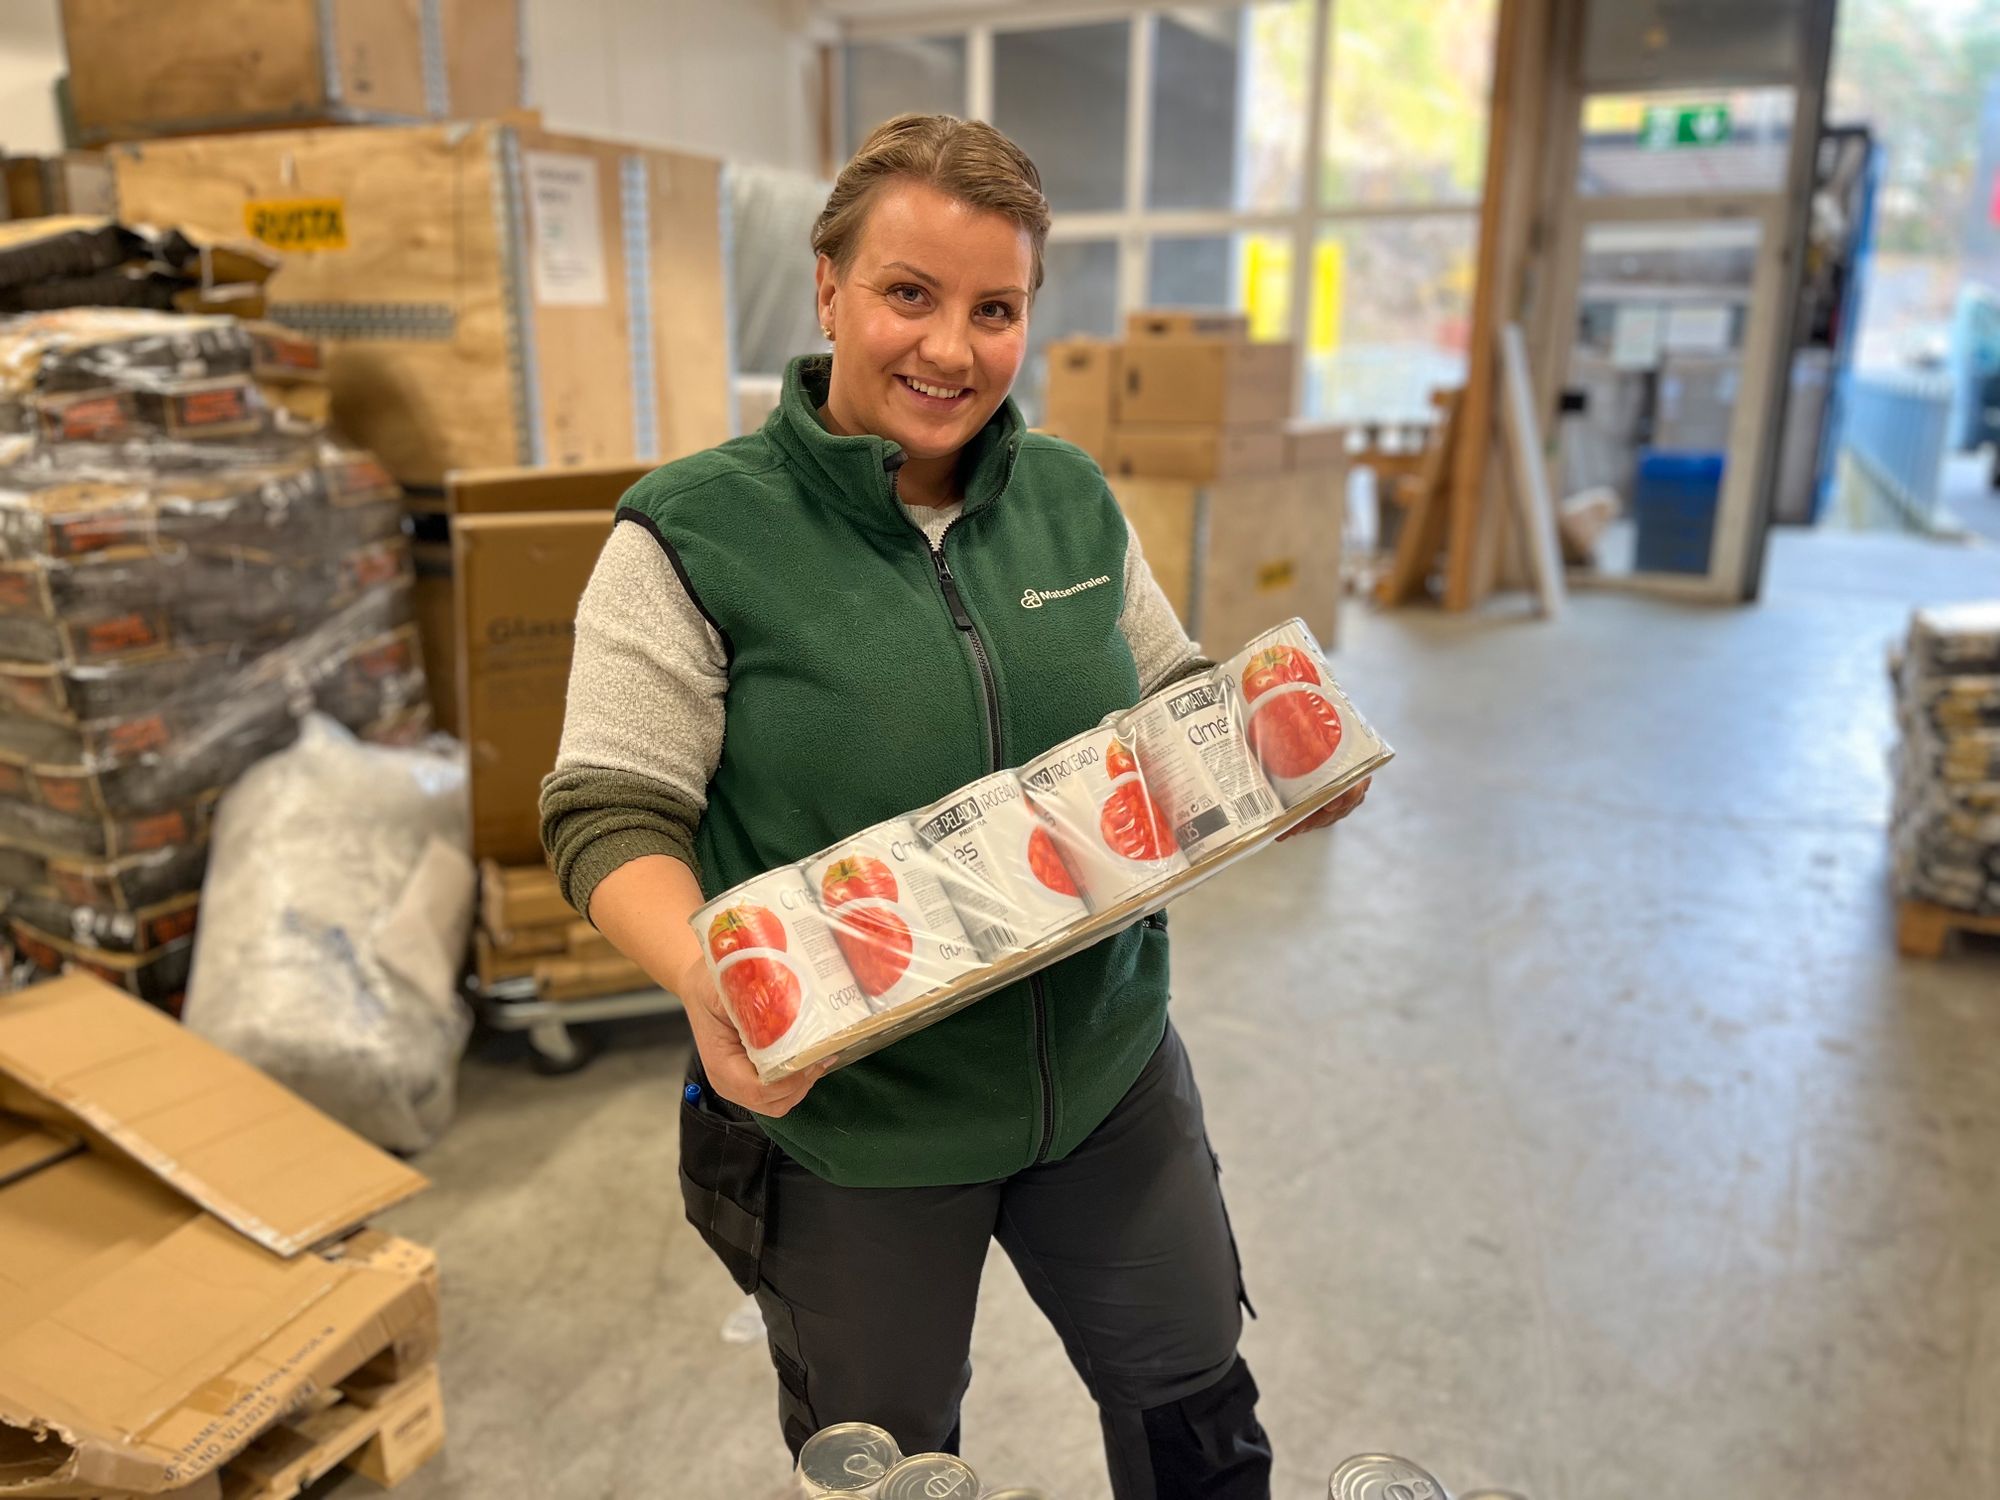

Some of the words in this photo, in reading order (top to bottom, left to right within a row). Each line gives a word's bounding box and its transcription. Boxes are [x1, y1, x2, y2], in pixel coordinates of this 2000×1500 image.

[1039, 575, 1111, 600] Matsentralen
[1049, 747, 1099, 781] TROCEADO
[943, 800, 979, 833] PELADO
